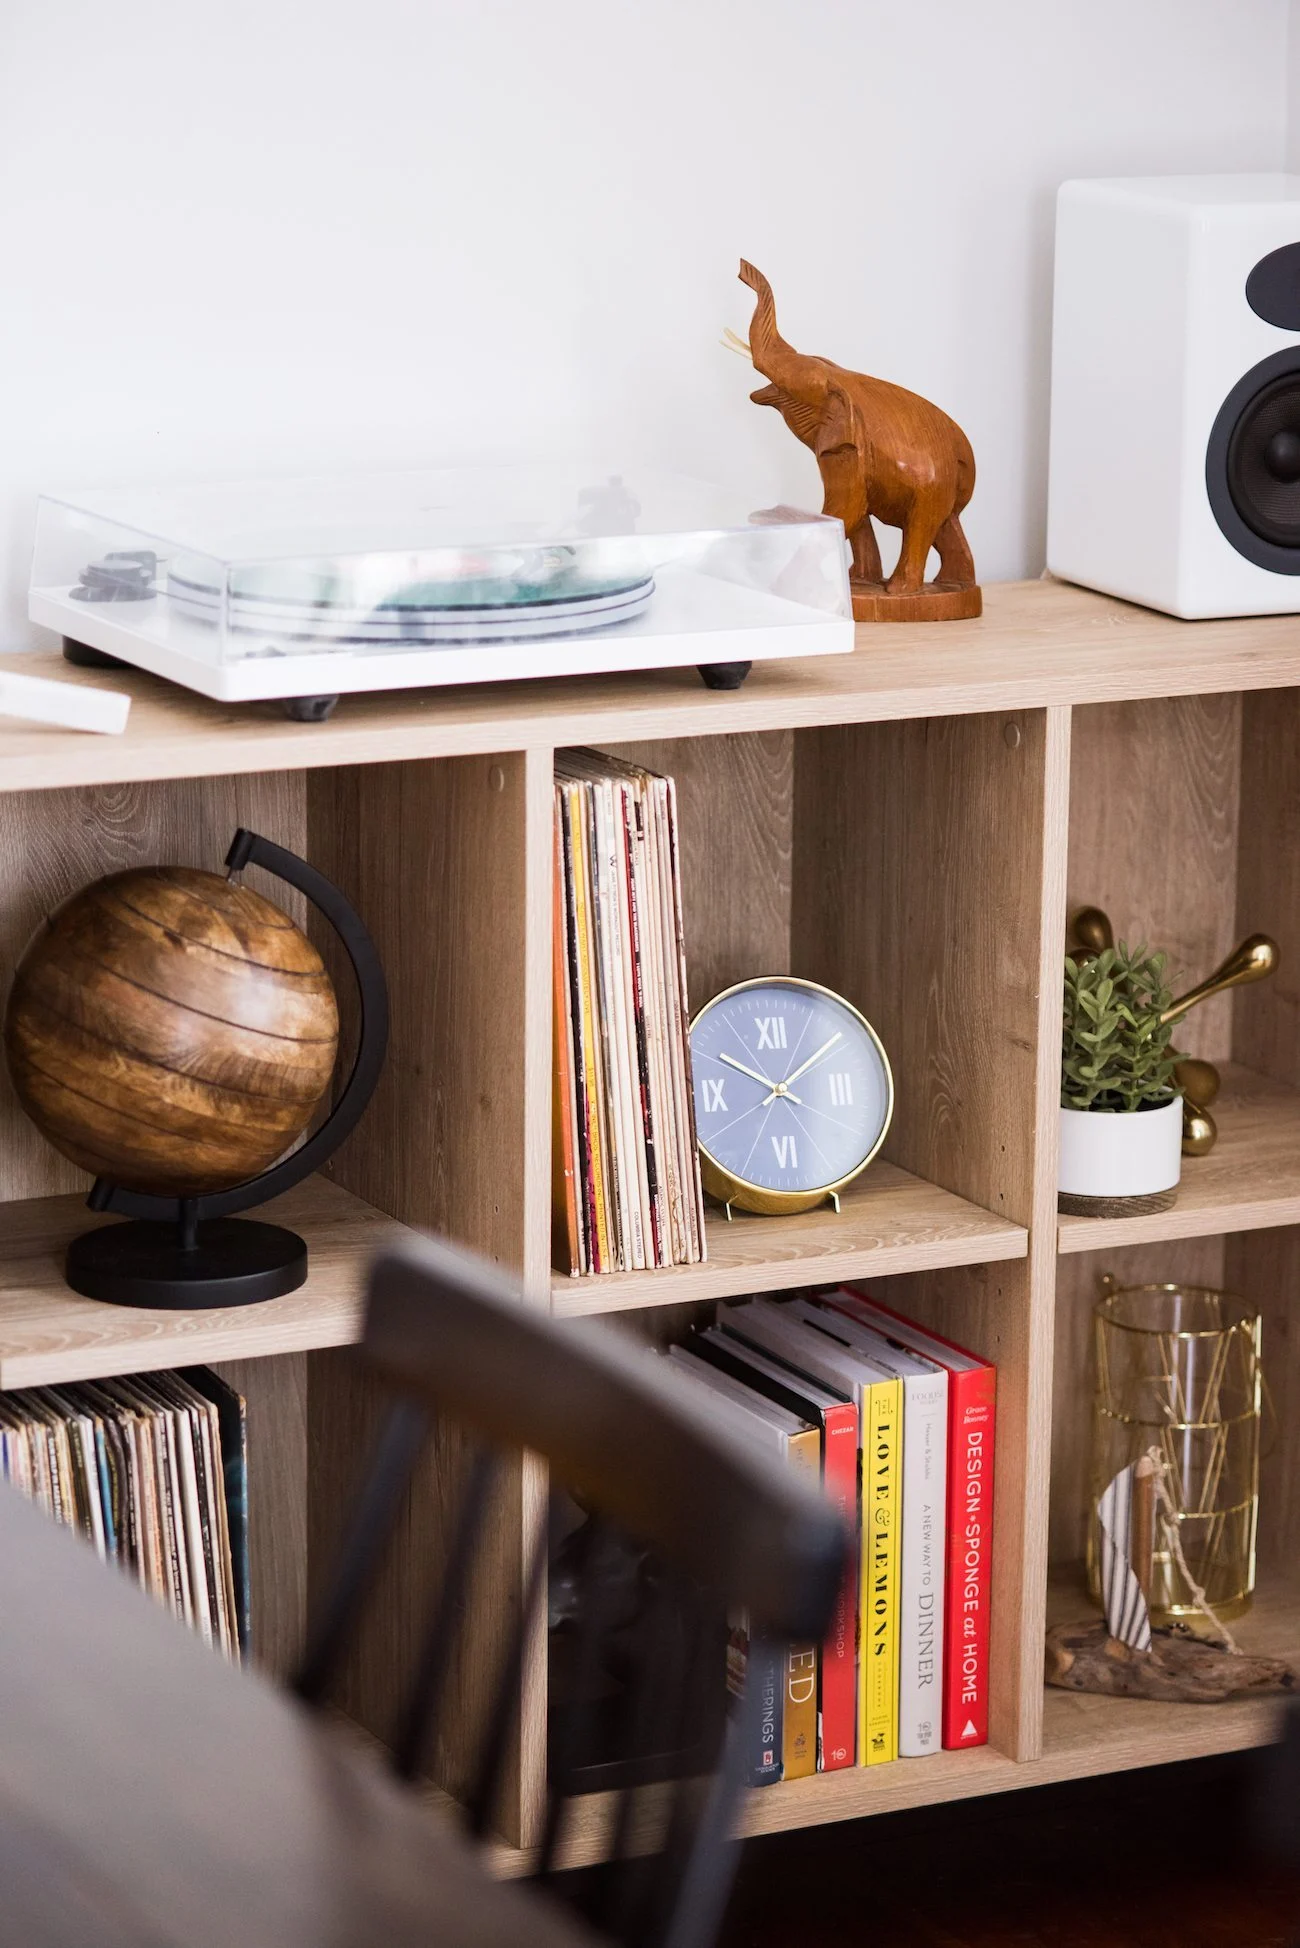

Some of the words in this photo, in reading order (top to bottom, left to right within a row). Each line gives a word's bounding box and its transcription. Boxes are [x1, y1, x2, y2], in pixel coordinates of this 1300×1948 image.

[755, 1017, 788, 1050] XII
[701, 1079, 729, 1113] IX
[828, 1073, 853, 1106] III
[771, 1136, 798, 1168] VI
[593, 1153, 601, 1187] RECORDS
[963, 1414, 989, 1425] Bonney
[965, 1405, 988, 1414] Grace
[876, 1423, 890, 1500] LOVE
[875, 1507, 890, 1527] &
[923, 1504, 931, 1513] A
[922, 1515, 931, 1541] NEW
[922, 1544, 931, 1569] WAY
[922, 1570, 931, 1586] TO
[873, 1532, 889, 1657] LEMONS
[917, 1592, 934, 1690] DINNER
[963, 1617, 976, 1638] at
[962, 1643, 978, 1705] HOME
